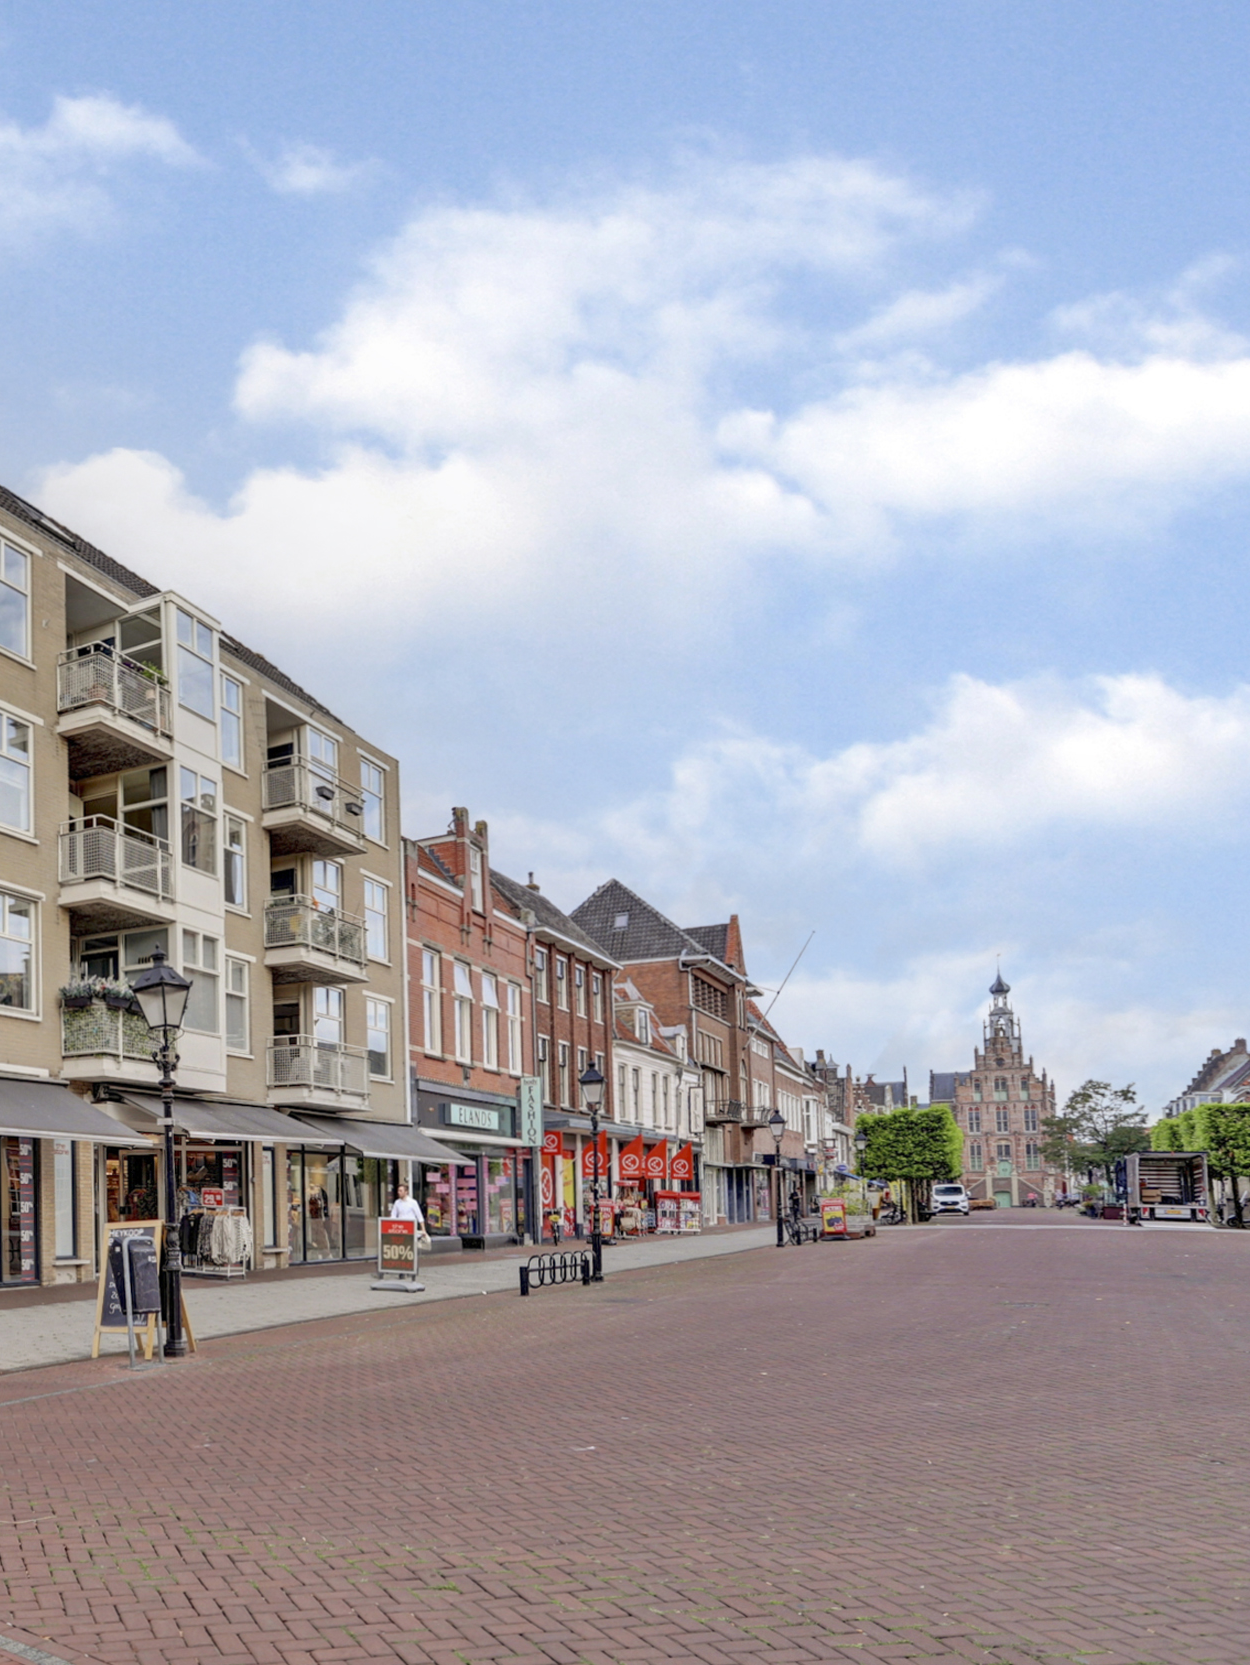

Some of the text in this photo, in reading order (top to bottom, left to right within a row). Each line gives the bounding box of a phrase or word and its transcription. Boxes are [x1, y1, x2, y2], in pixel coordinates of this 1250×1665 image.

[458, 1106, 492, 1127] ELANDS
[527, 1085, 537, 1145] FASHION
[383, 1244, 414, 1261] 50%
